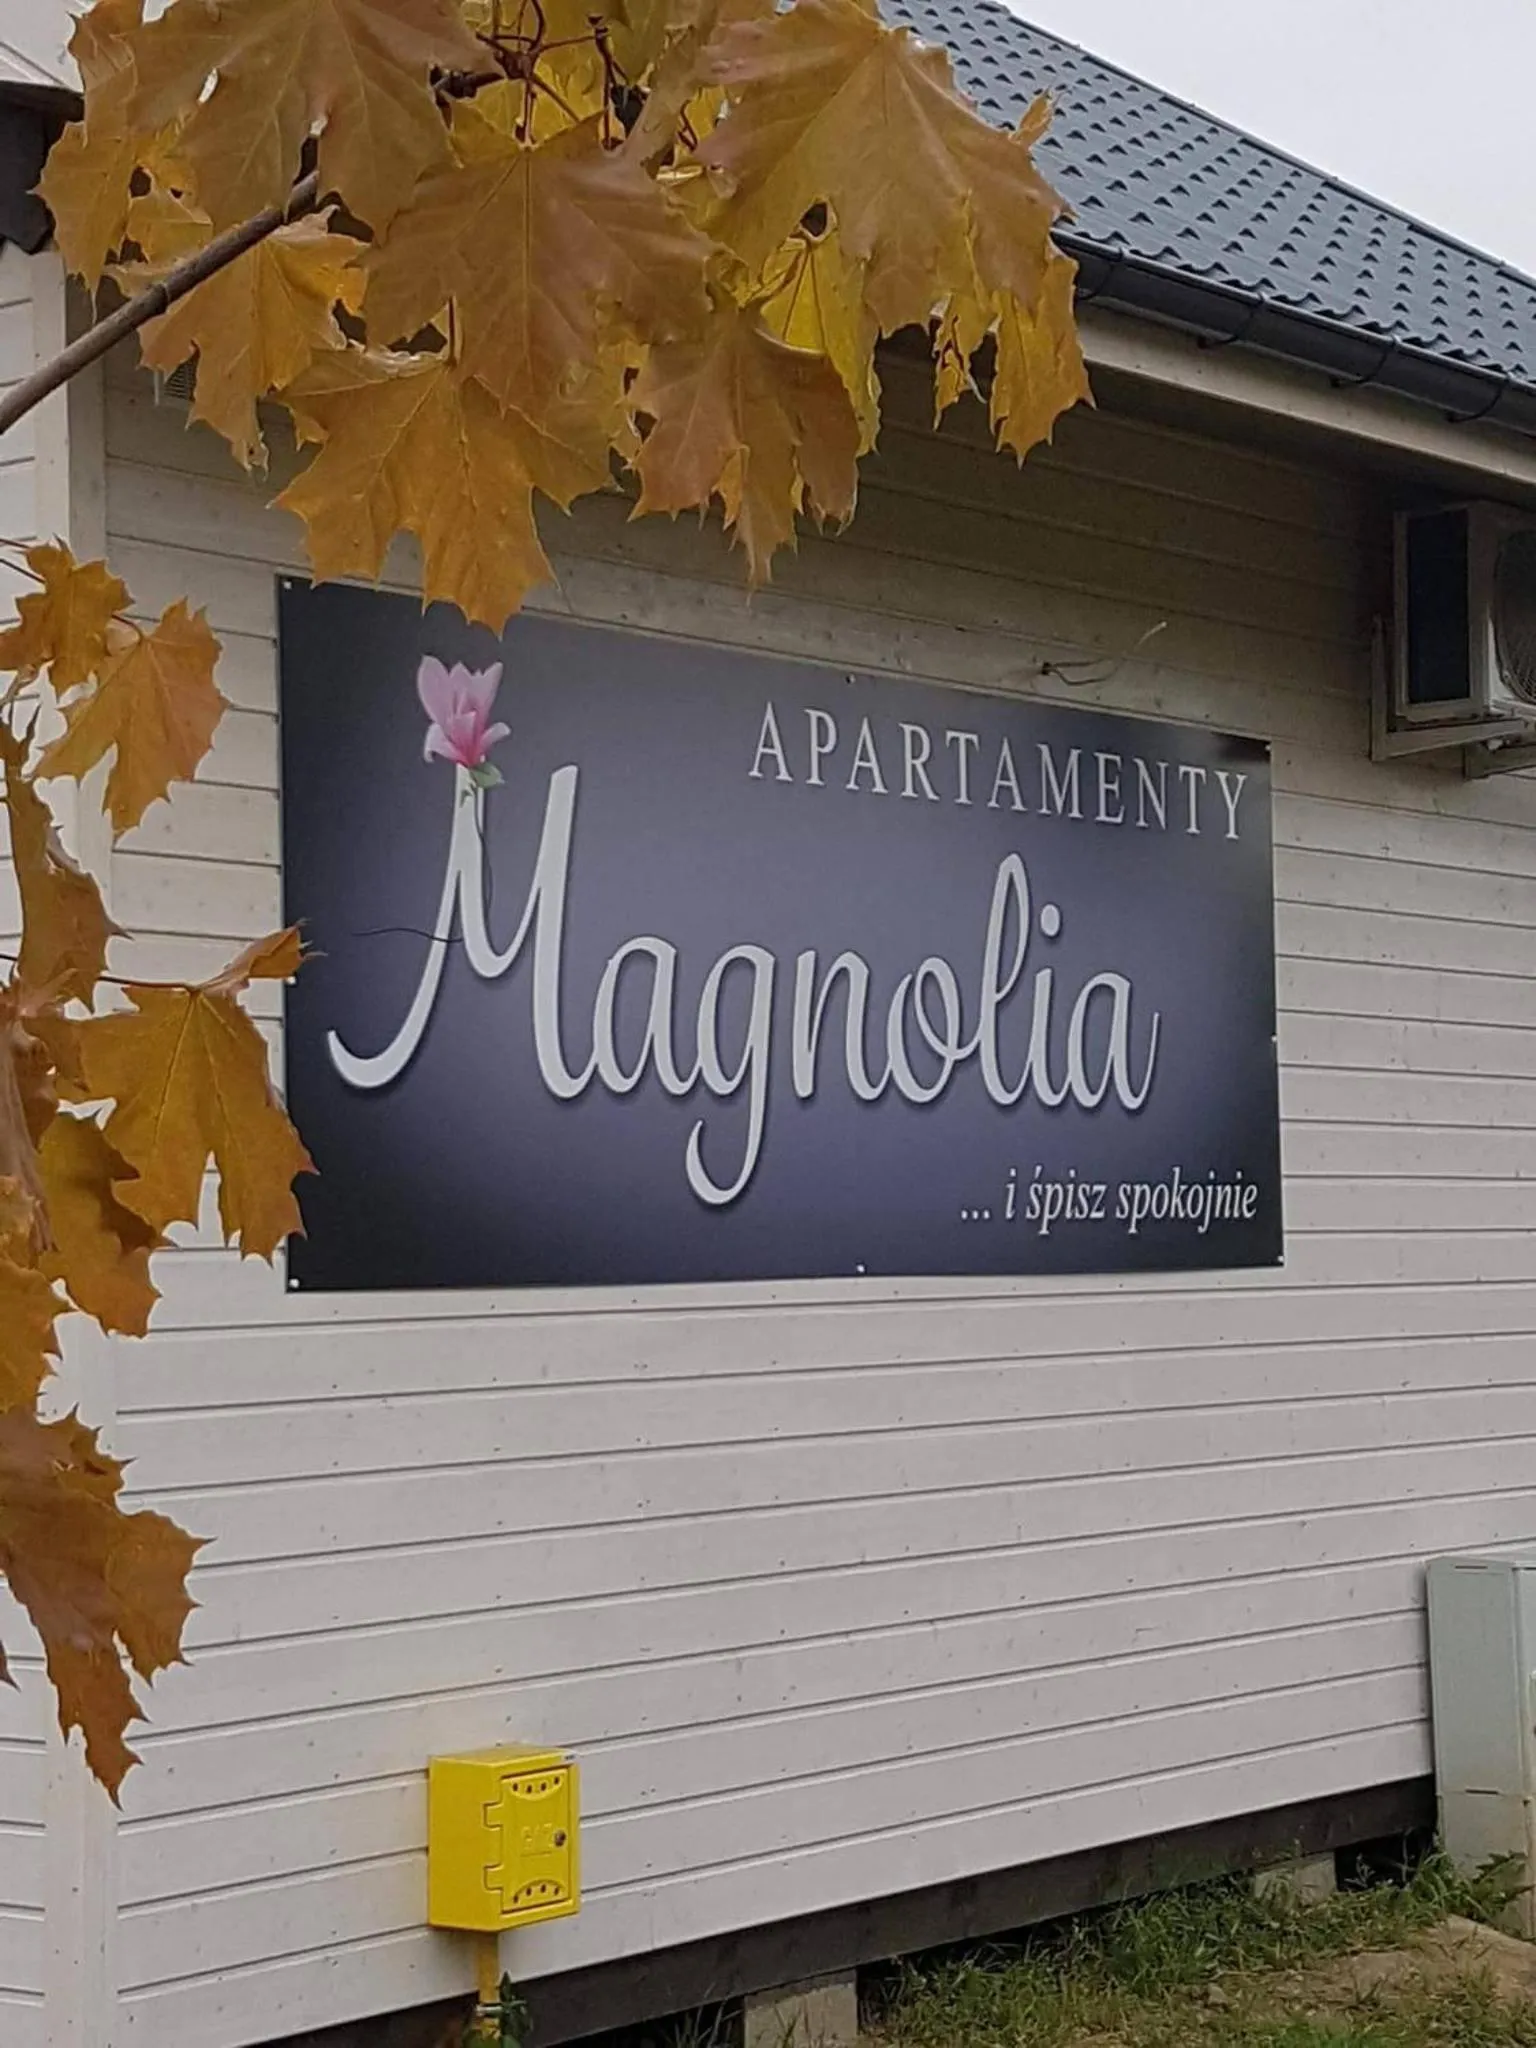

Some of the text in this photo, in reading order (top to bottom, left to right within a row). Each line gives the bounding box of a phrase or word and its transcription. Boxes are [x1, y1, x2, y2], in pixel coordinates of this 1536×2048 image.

[749, 701, 1248, 840] APARTAMENTY
[327, 765, 1159, 1205] Magnolia
[1005, 1168, 1017, 1219] i
[1026, 1166, 1108, 1235] śpisz
[1116, 1166, 1258, 1234] spokojnie
